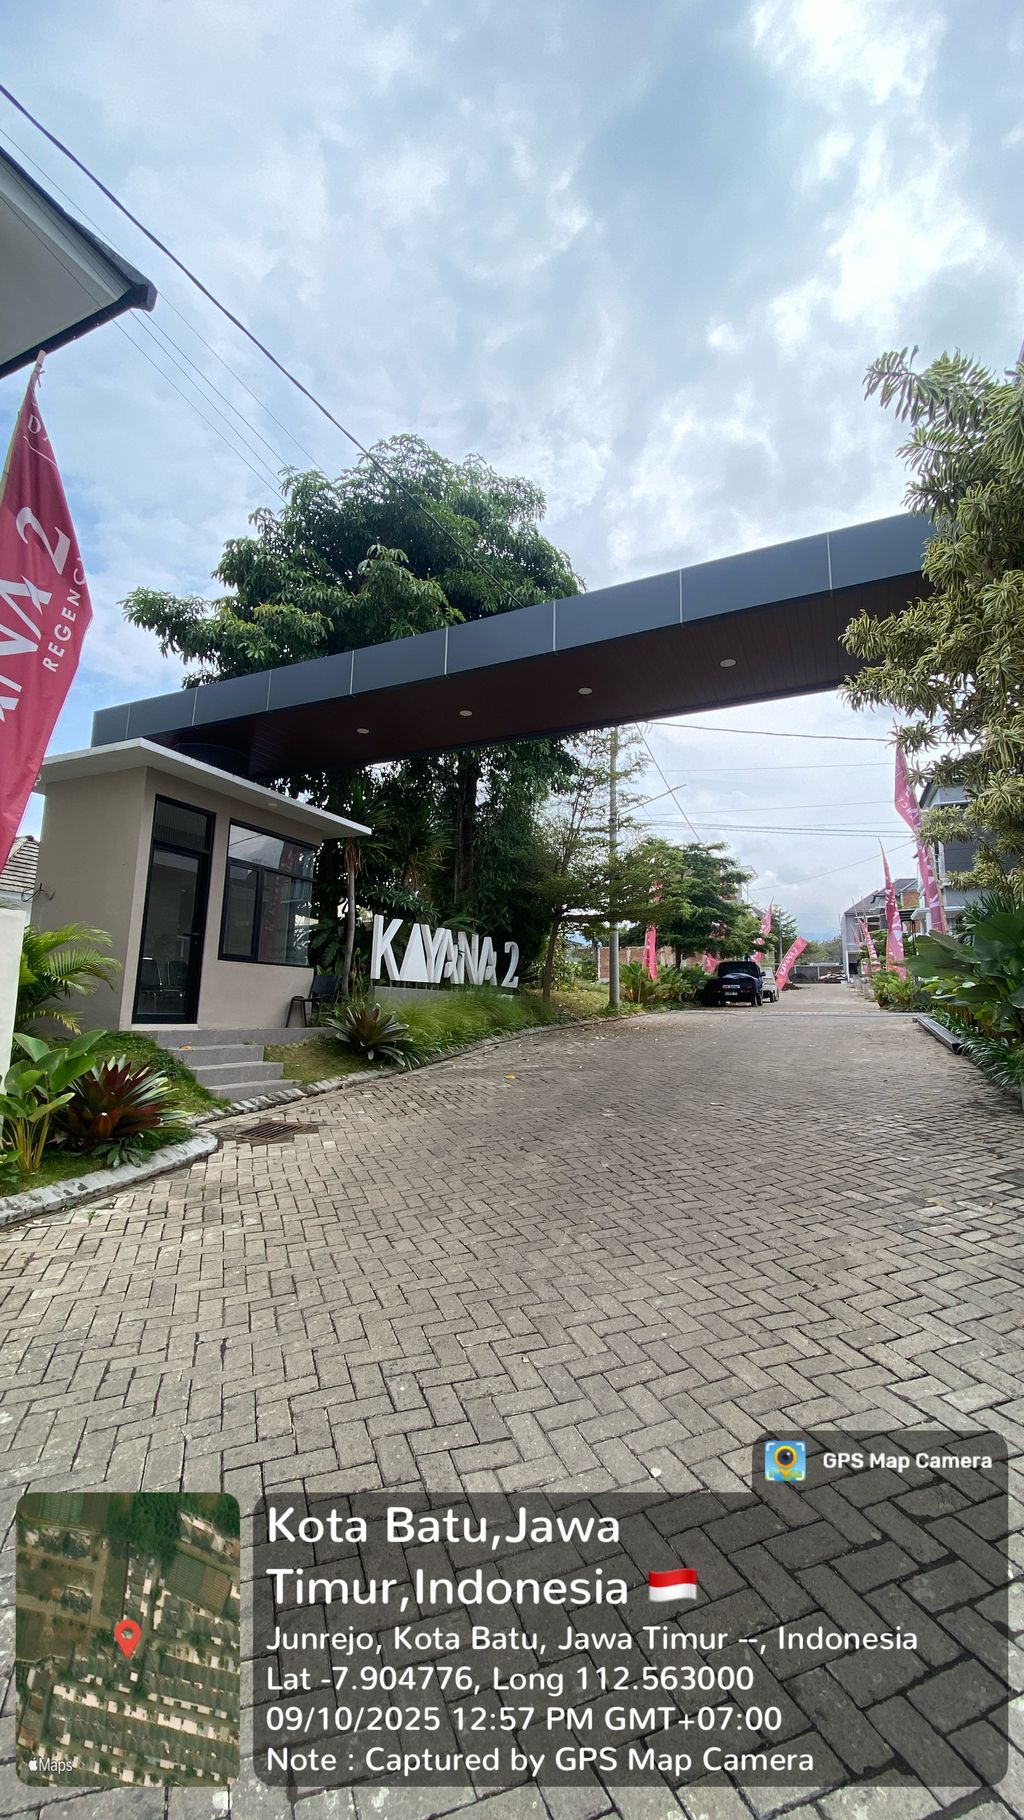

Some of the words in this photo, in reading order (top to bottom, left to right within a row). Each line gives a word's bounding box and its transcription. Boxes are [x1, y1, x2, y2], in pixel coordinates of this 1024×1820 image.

[16, 506, 71, 575] 2
[43, 556, 87, 673] REGENC
[370, 914, 498, 985] KAYANA
[501, 941, 519, 988] 2
